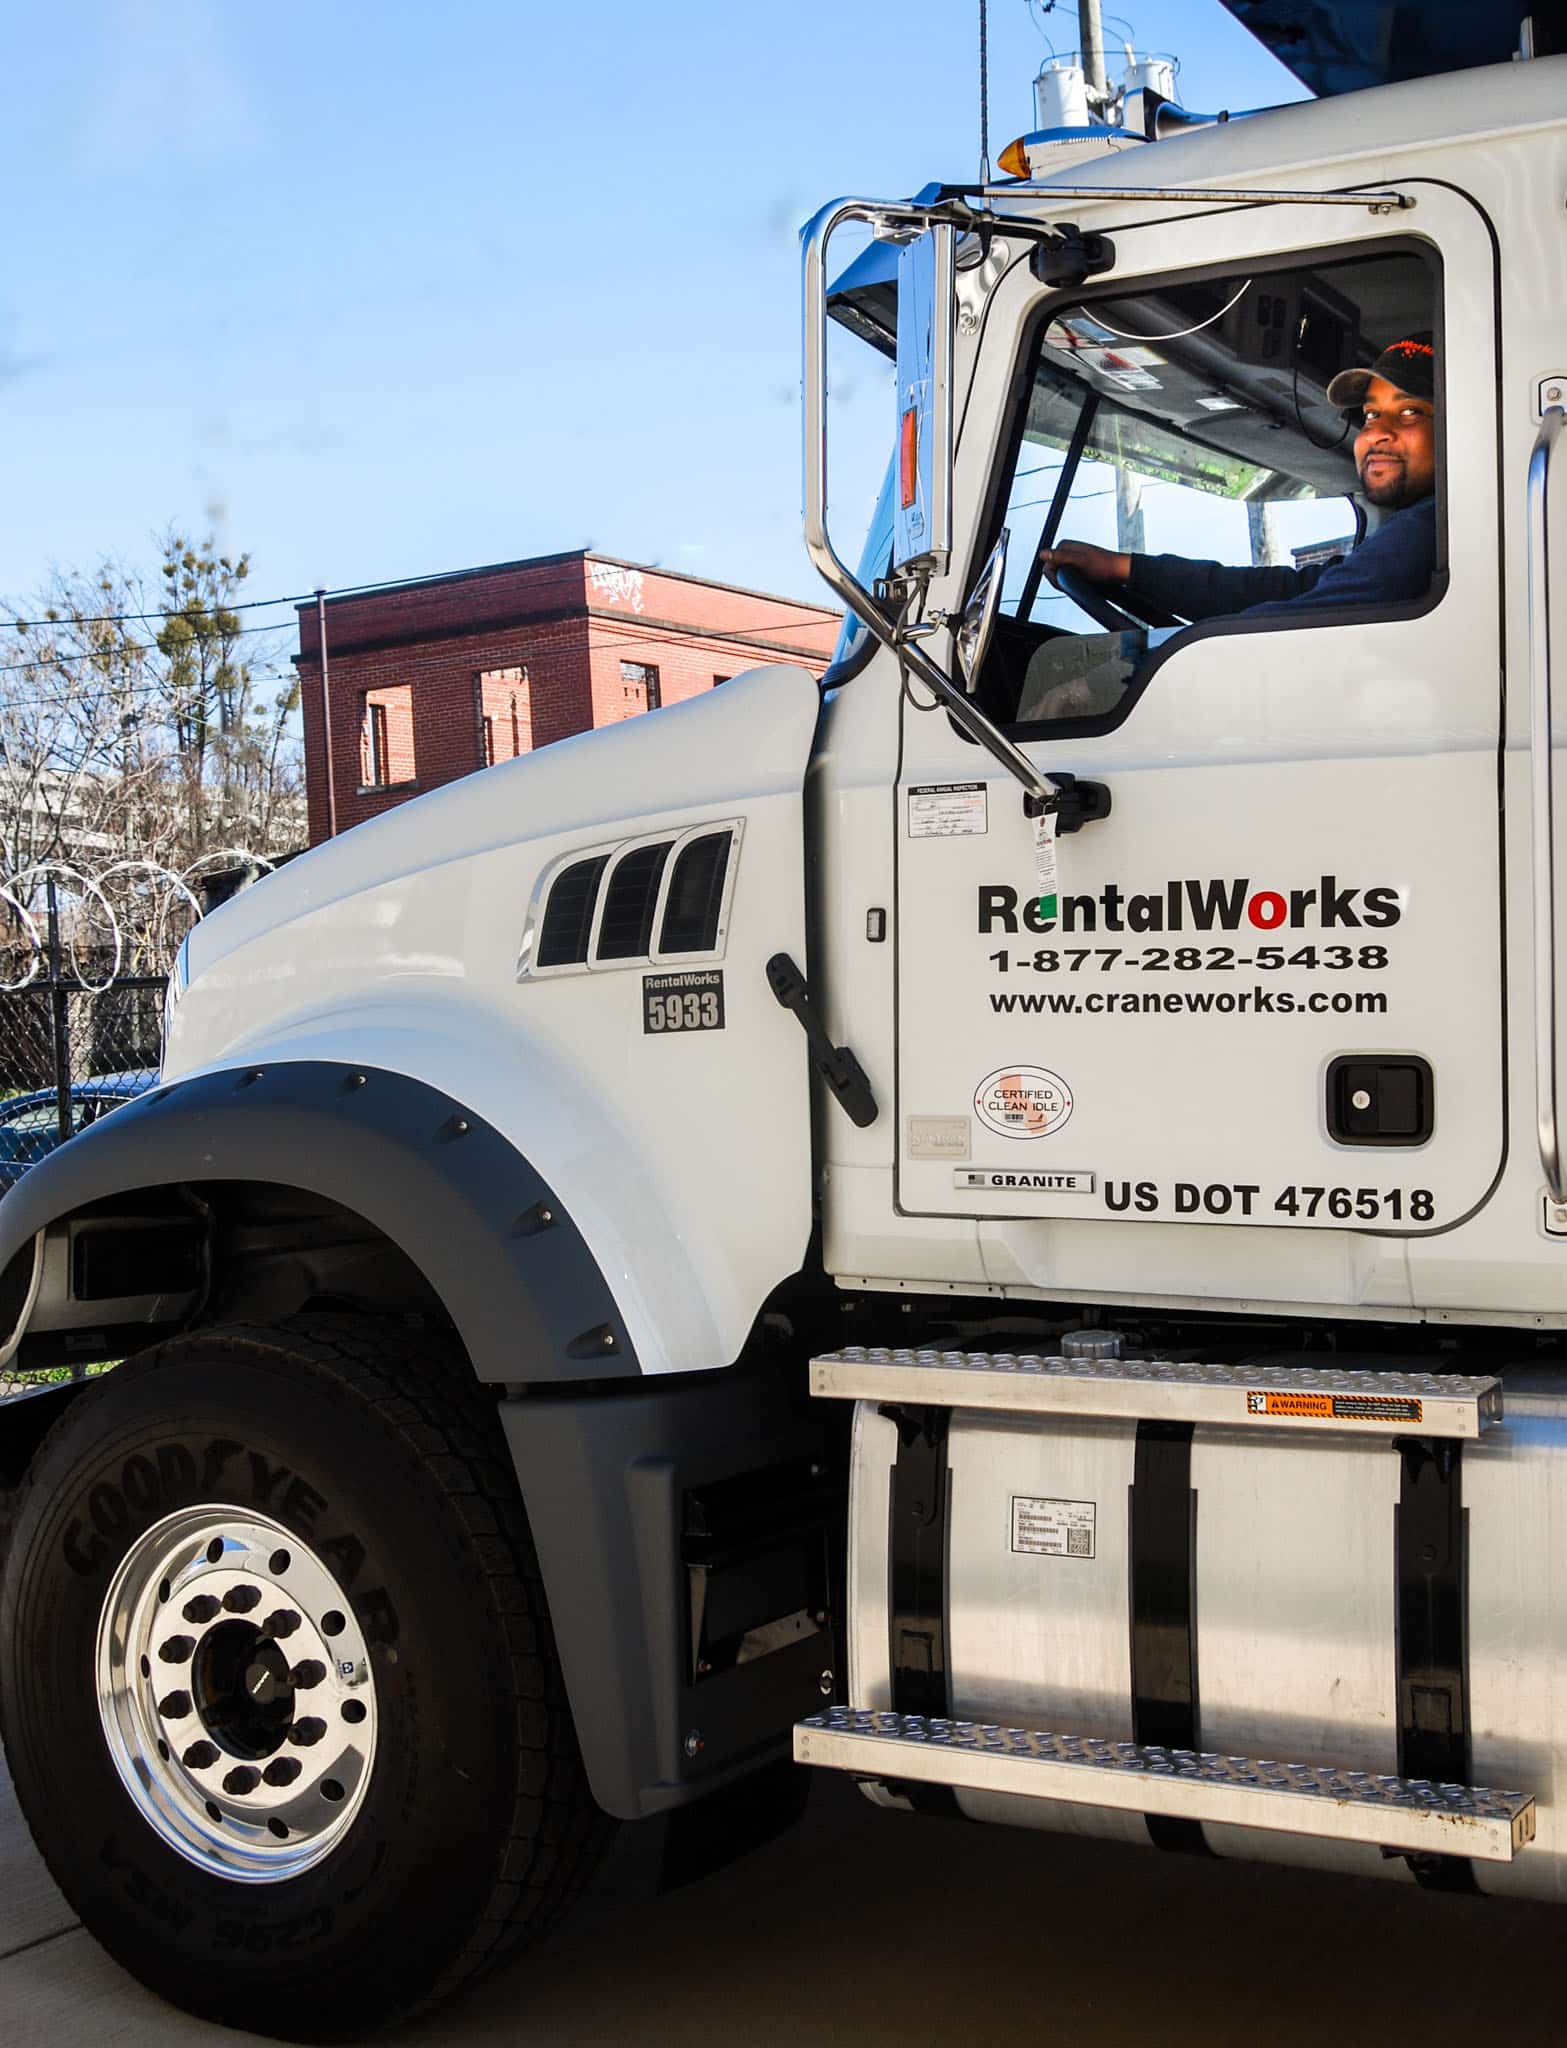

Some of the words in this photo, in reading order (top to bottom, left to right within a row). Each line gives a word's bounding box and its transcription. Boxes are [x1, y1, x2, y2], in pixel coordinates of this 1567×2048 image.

[978, 875, 1401, 934] RentalWorks
[989, 945, 1389, 973] 1-877-282-5438
[645, 973, 720, 989] RentalWorks
[989, 985, 1388, 1014] www.craneworks.com
[648, 992, 719, 1030] 5933
[993, 1089, 1053, 1099] CERTIFIED
[988, 1101, 1028, 1111] CLEAN
[1032, 1102, 1059, 1112] IDLE
[991, 1174, 1076, 1189] GRANITE
[1104, 1181, 1159, 1212] US
[1174, 1183, 1260, 1216] DOT
[1274, 1185, 1435, 1222] 476518
[1280, 1399, 1328, 1411] WARNING
